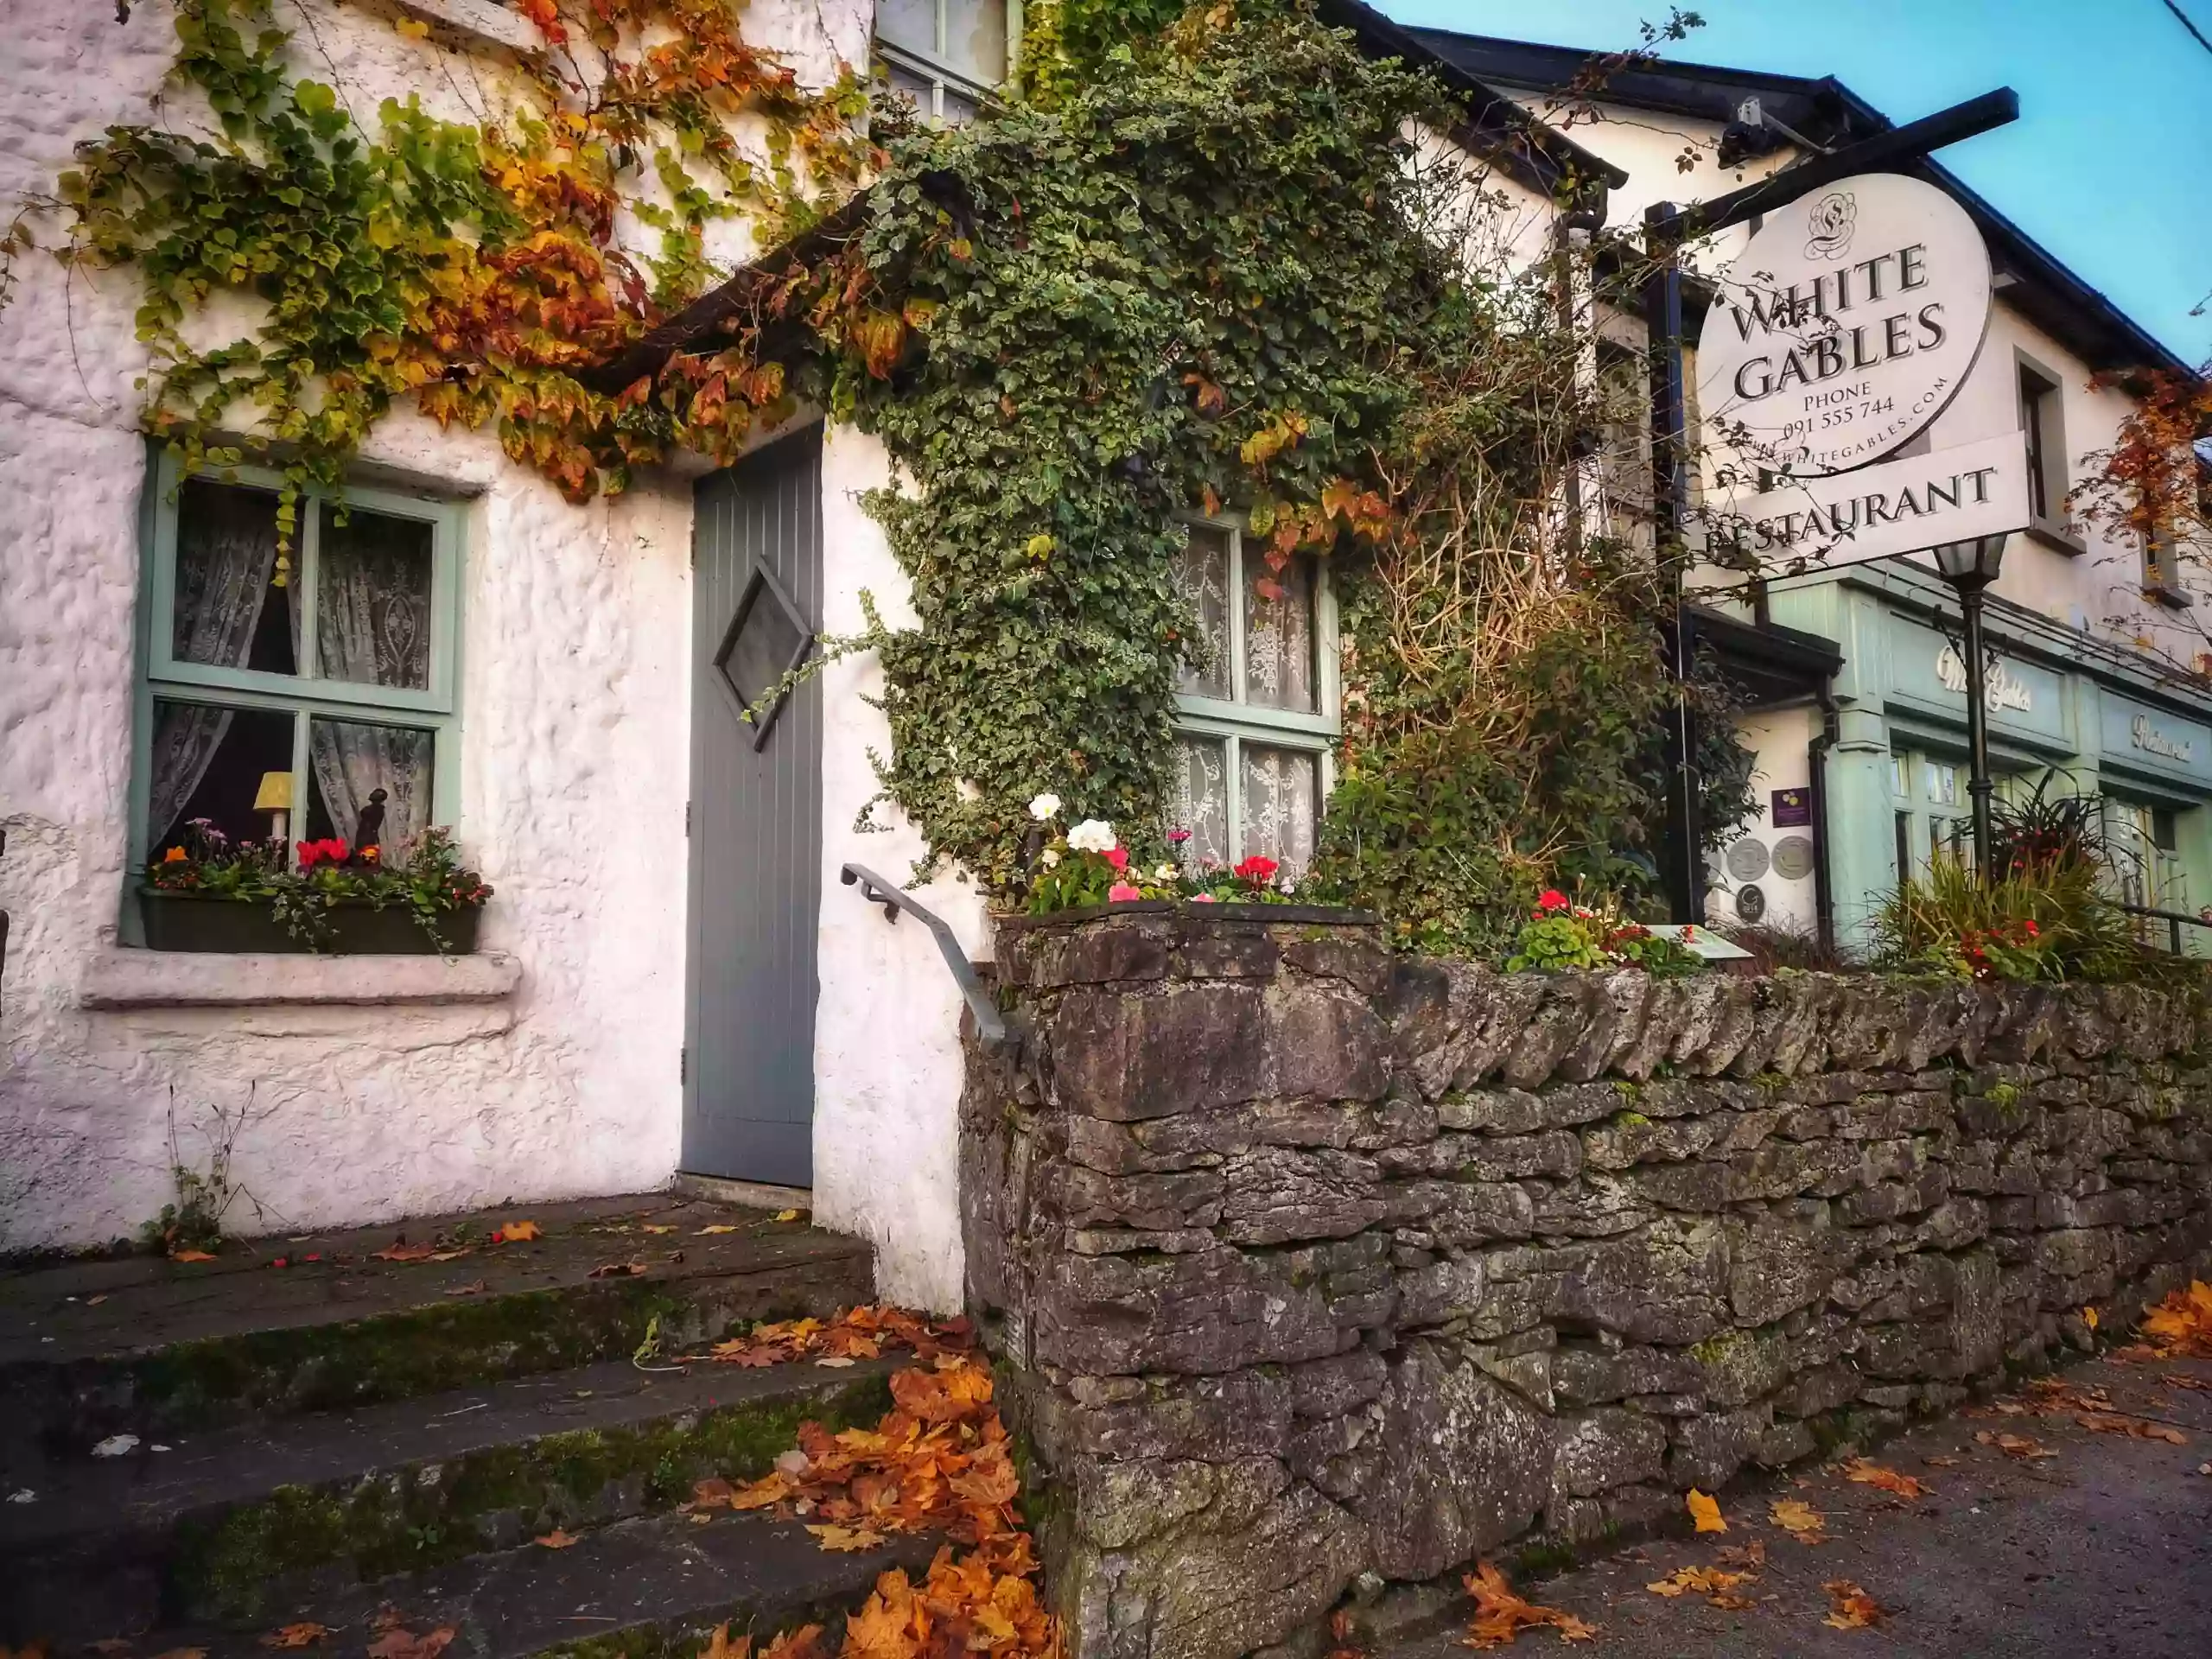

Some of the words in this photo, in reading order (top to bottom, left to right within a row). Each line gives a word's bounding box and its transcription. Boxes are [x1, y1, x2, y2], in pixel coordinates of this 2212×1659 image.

[1728, 242, 1929, 344] WHITE
[1733, 302, 1948, 403] GABLES
[1783, 417, 1815, 440] 091
[1821, 409, 1854, 430] 555
[1860, 397, 1895, 418] 744
[1803, 380, 1872, 412] PHONE
